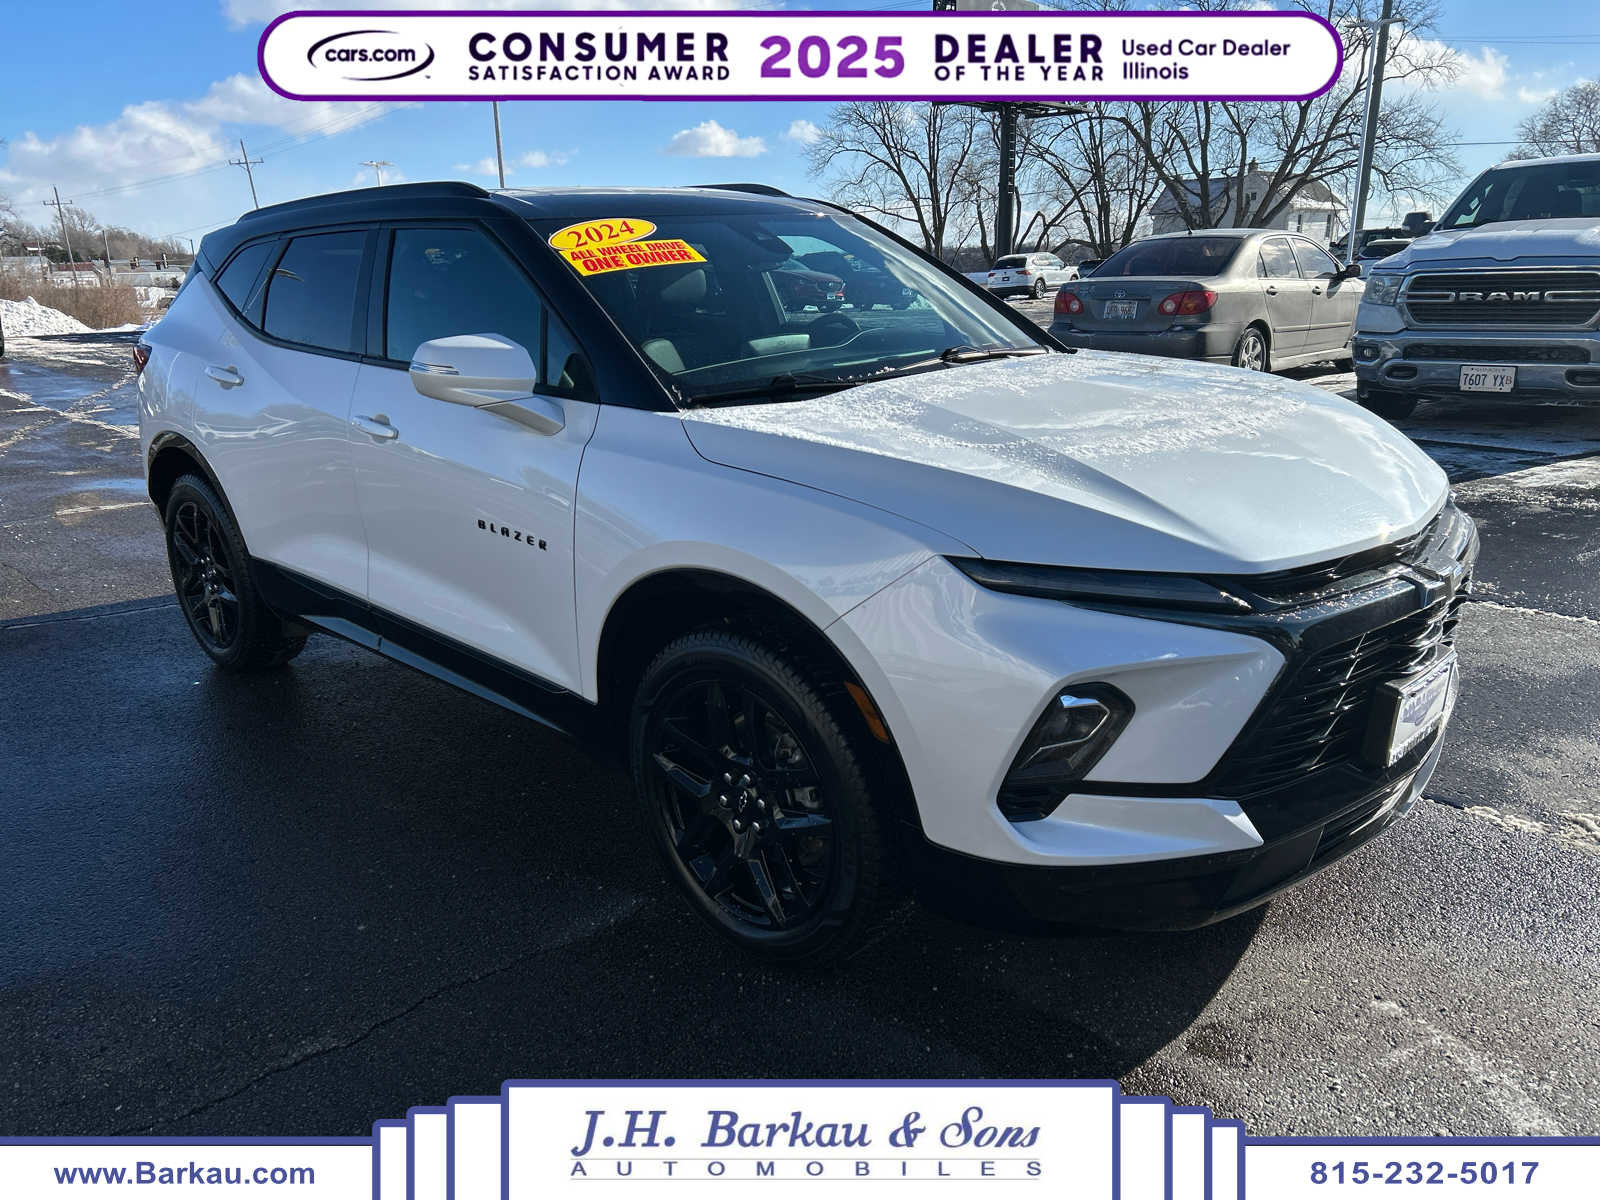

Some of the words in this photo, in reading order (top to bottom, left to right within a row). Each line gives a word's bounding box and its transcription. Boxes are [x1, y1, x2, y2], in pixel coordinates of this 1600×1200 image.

[567, 220, 635, 248] 2024
[569, 248, 596, 262] ALL
[598, 242, 643, 258] WHEEL
[645, 240, 686, 252] DRIVE
[582, 255, 627, 272] ONE
[626, 249, 693, 265] OWNER
[1459, 291, 1541, 301] RAM
[1463, 373, 1488, 386] 7607
[477, 519, 547, 552] BLAZER
